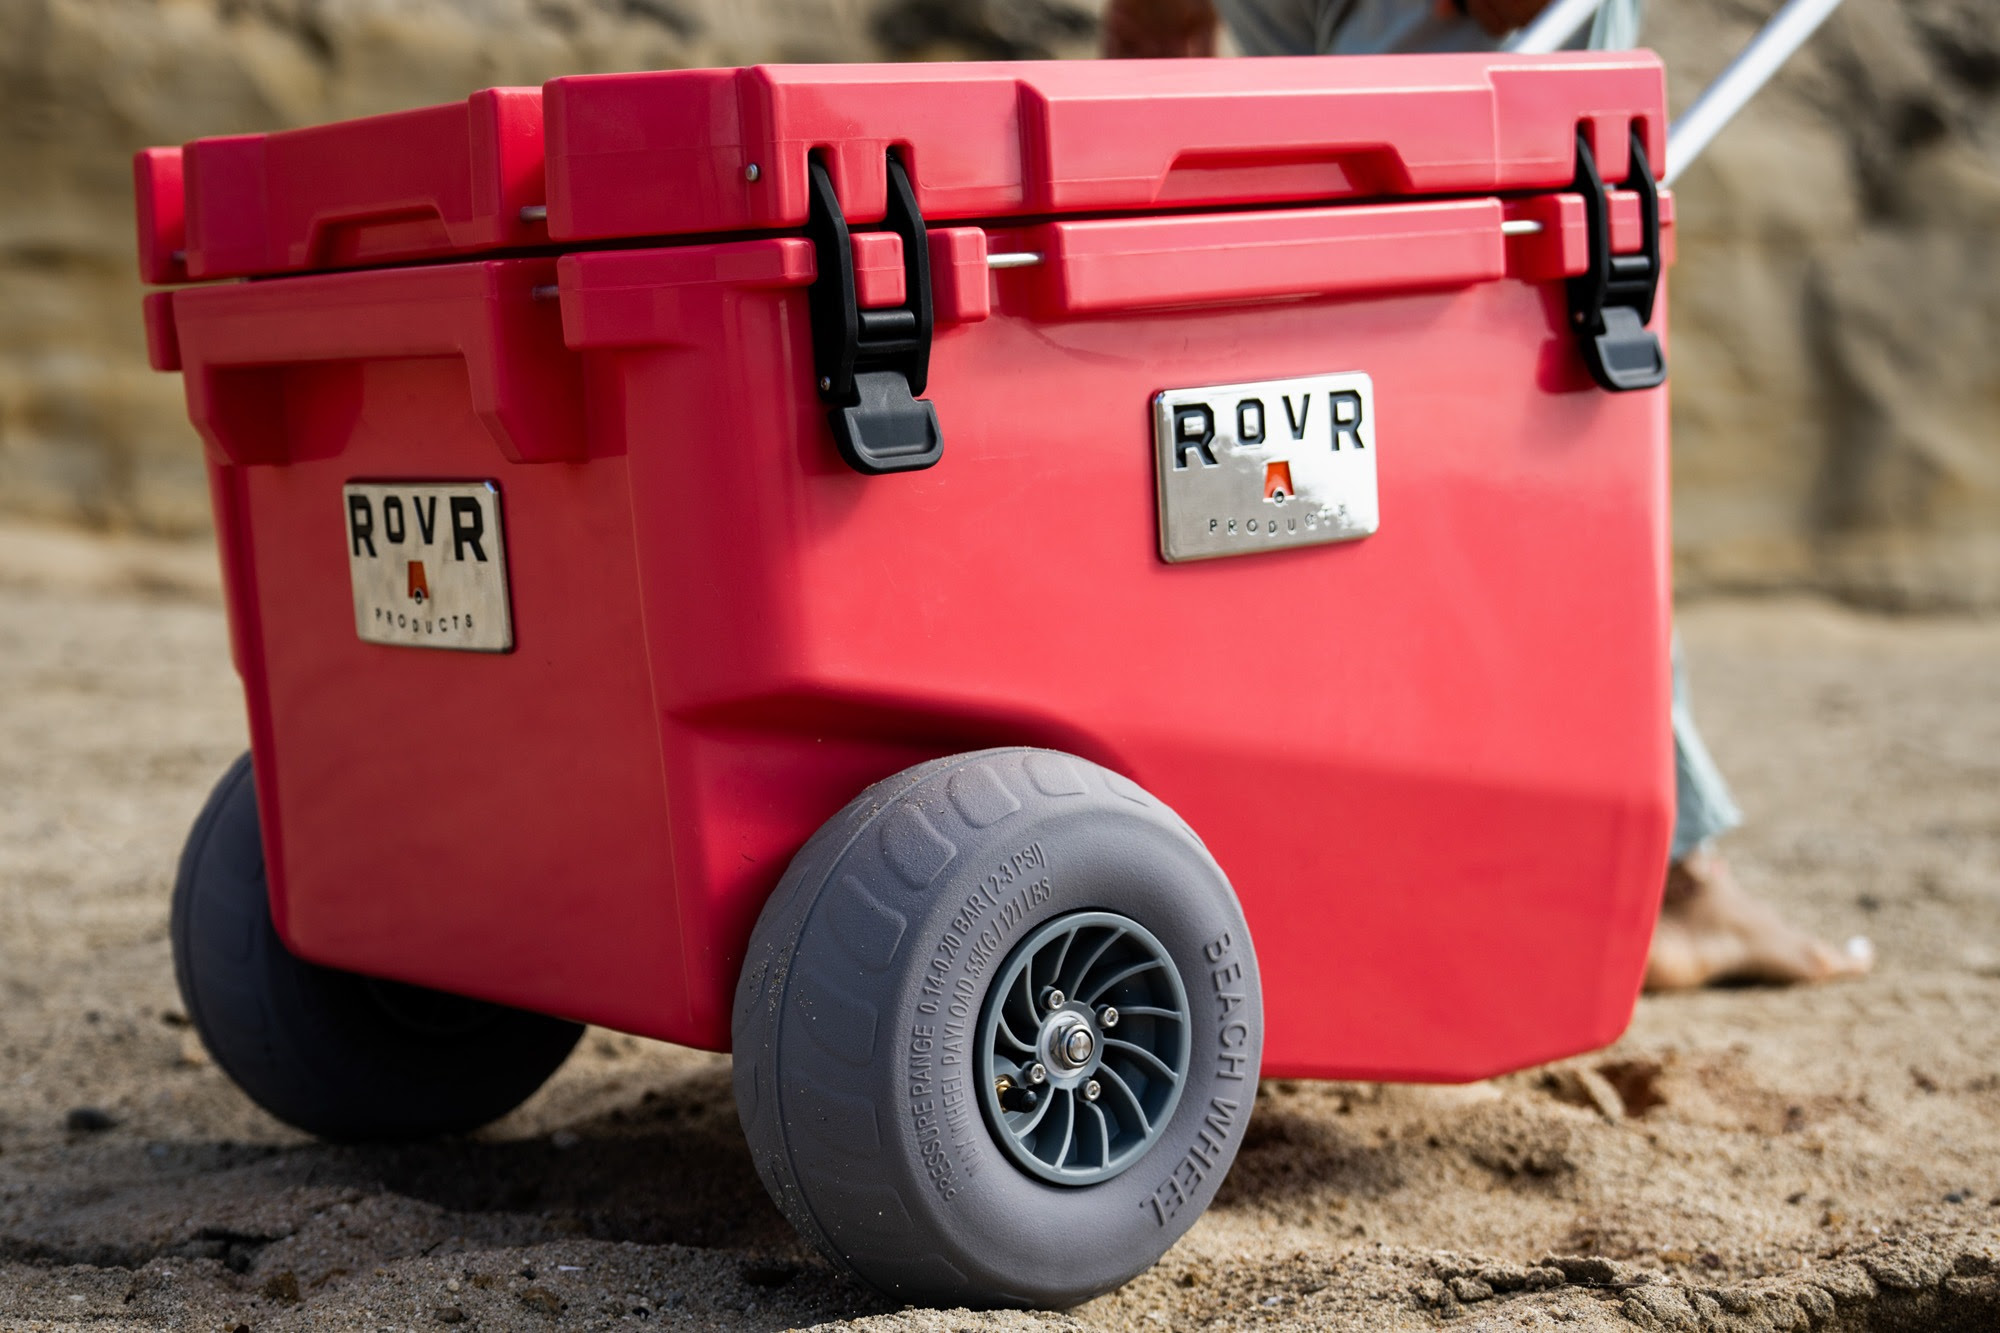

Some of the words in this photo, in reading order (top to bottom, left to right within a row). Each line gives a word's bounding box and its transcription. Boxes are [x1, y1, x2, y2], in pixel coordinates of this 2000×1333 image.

[1173, 389, 1365, 469] ROVR
[348, 495, 488, 562] ROVR
[1209, 504, 1347, 534] PRODUCTS
[375, 608, 473, 634] PRODUCTS
[953, 893, 988, 935] BAR
[999, 897, 1024, 931] 121
[1021, 876, 1051, 912] LBS
[918, 932, 962, 1015] 0.14-0.20
[964, 930, 998, 979] 55KG
[941, 977, 976, 1066] PAYLOAD
[1205, 927, 1249, 1081] BEACH
[911, 1024, 936, 1097] RANGE
[941, 1069, 974, 1141] WHEEL
[913, 1099, 963, 1201] PRESSURE
[1140, 1096, 1239, 1227] WHEEL
